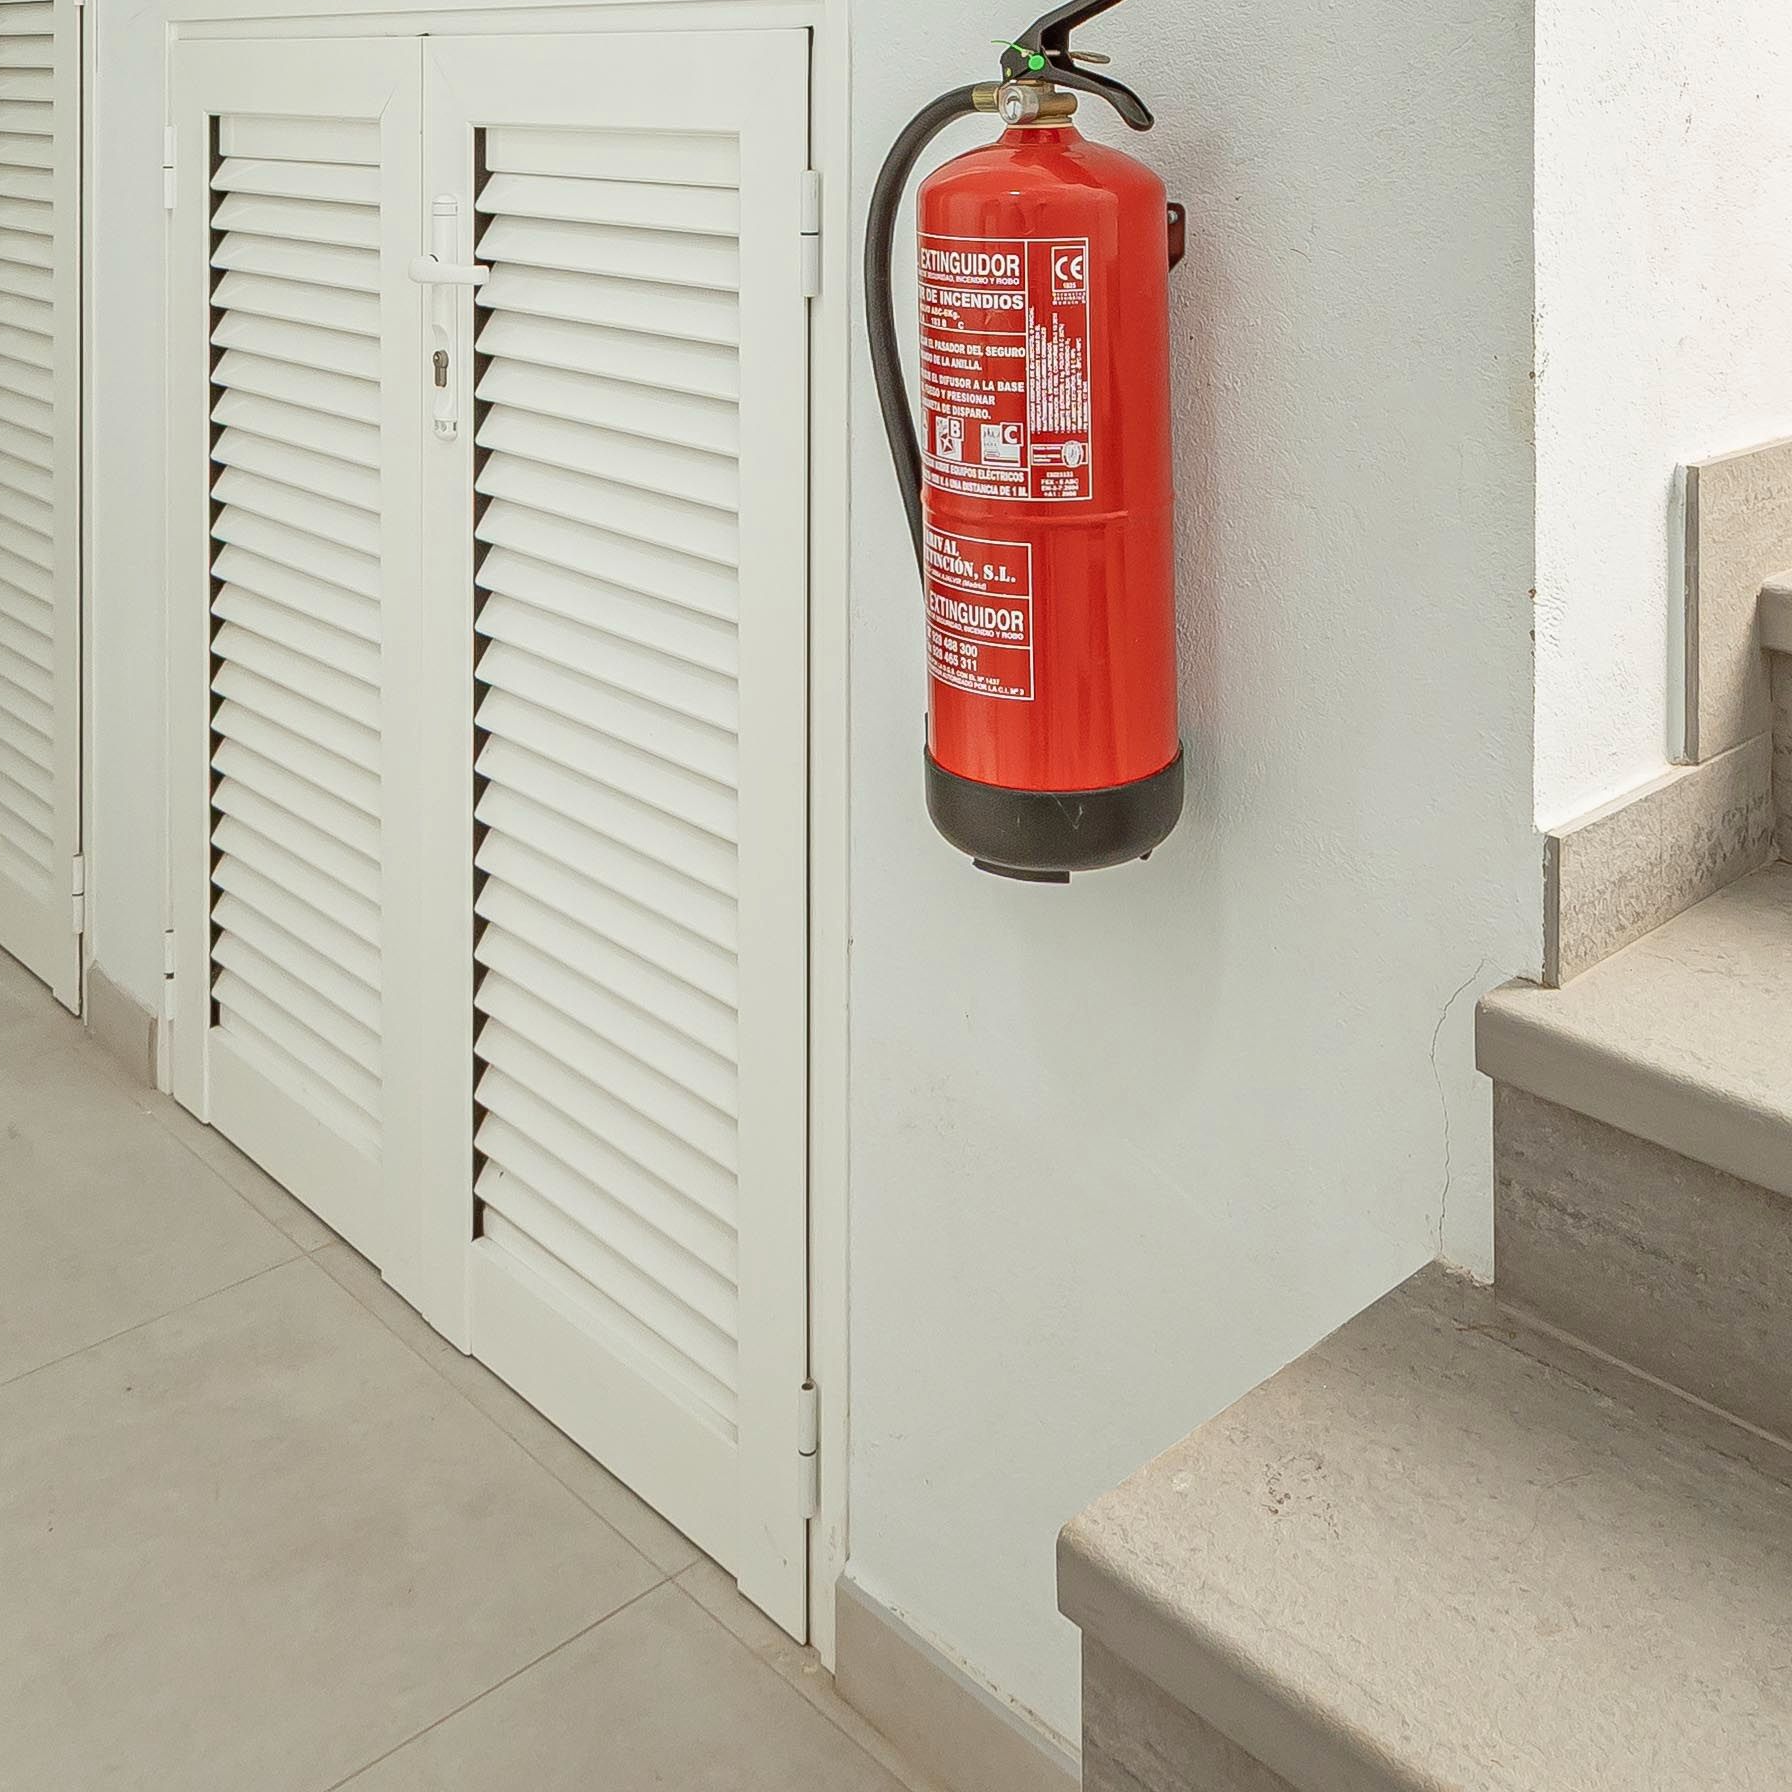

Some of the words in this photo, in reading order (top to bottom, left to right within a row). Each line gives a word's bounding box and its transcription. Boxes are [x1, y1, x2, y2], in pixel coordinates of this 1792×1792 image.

[921, 248, 1020, 277] EXTINGUIDOR
[989, 277, 995, 285] Y
[996, 277, 1020, 286] ROBO
[926, 288, 938, 304] DE
[939, 290, 1024, 310] INCENDIOS
[934, 339, 966, 354] PASADOR
[967, 344, 984, 356] DEL
[985, 346, 1026, 357] SEGURO
[939, 374, 971, 389] DIFUSOR
[973, 380, 980, 390] A
[982, 380, 995, 391] LA
[997, 381, 1025, 392] BASE
[946, 390, 996, 406] PRESIONAR
[952, 405, 992, 420] DISPARO.
[950, 419, 961, 438] B
[1003, 426, 1018, 444] C
[999, 486, 1011, 496] DE
[1012, 486, 1016, 496] 1
[983, 564, 1016, 583] S.L.
[929, 591, 1024, 632] EXTINGUIDOR
[959, 642, 978, 658] 300
[960, 656, 977, 671] 311
